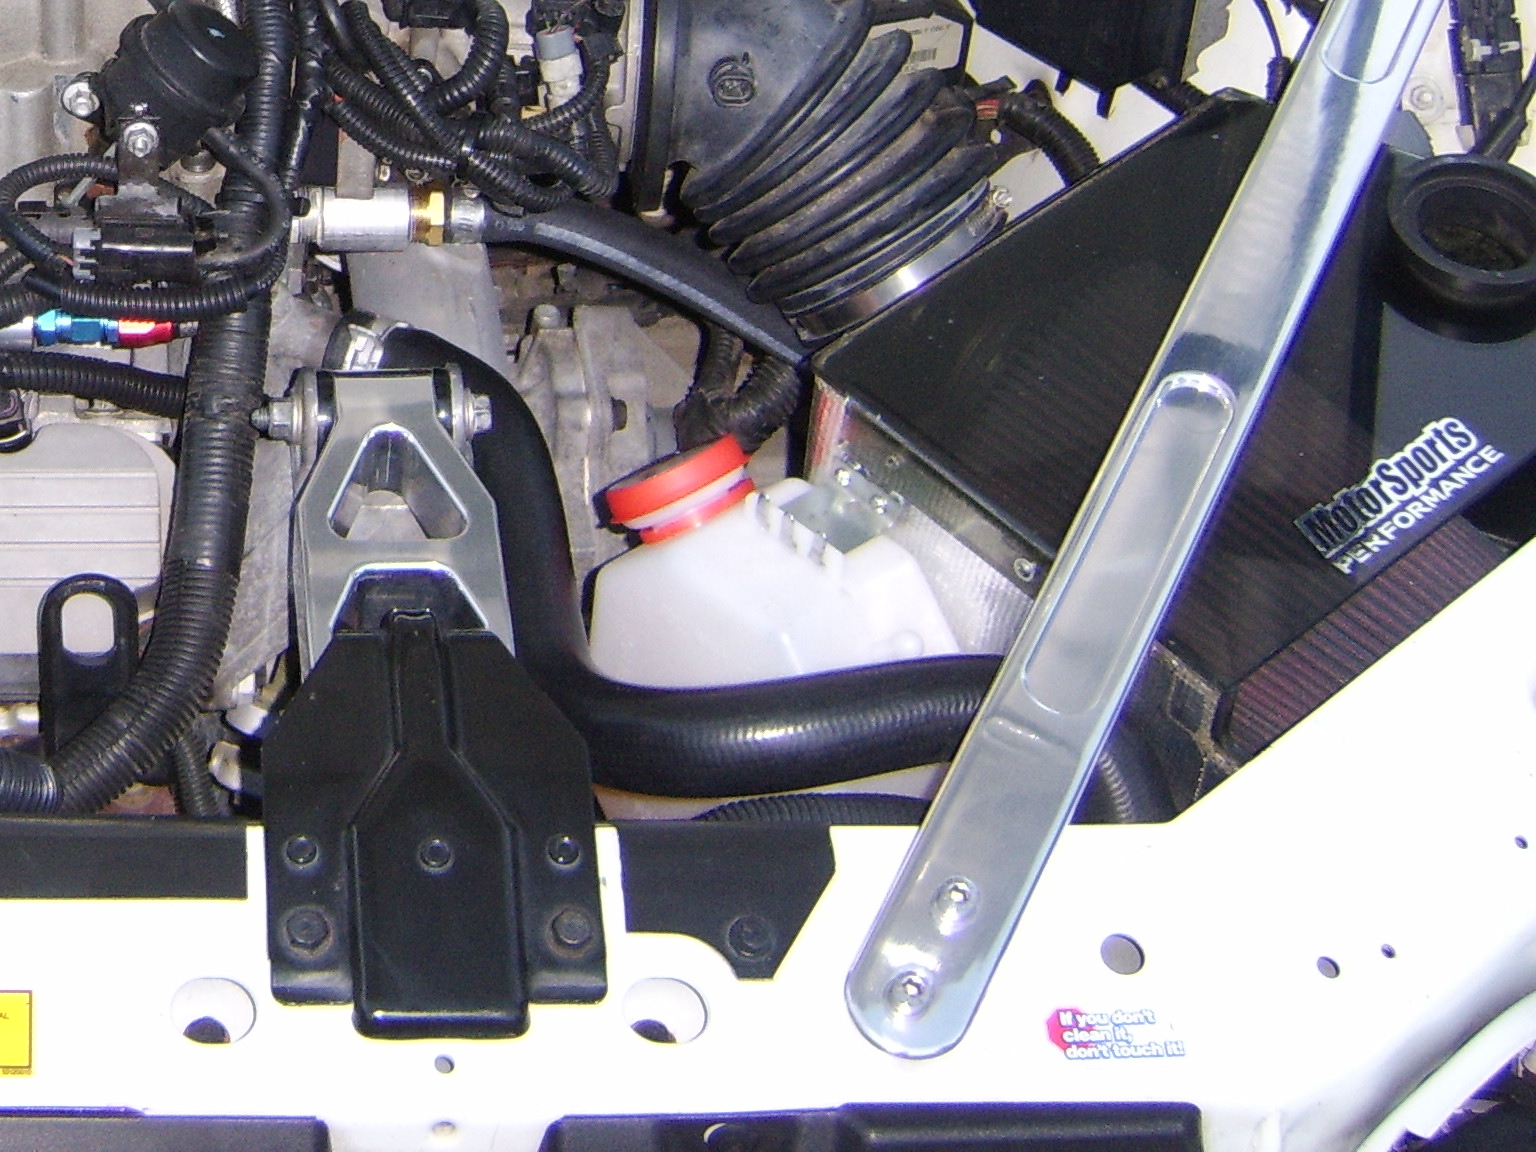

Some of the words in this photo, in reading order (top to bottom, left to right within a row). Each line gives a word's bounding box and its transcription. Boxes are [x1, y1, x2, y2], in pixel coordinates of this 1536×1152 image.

[1294, 417, 1478, 559] MotorSports
[1331, 445, 1506, 576] PERFORMANCE
[1059, 1011, 1074, 1027] If
[1075, 1013, 1110, 1028] you
[1112, 1009, 1156, 1025] don't
[1062, 1028, 1112, 1044] clean
[1113, 1026, 1133, 1044] it,
[1064, 1044, 1111, 1060] don't
[1112, 1042, 1165, 1058] touch
[1164, 1040, 1186, 1057] it!
